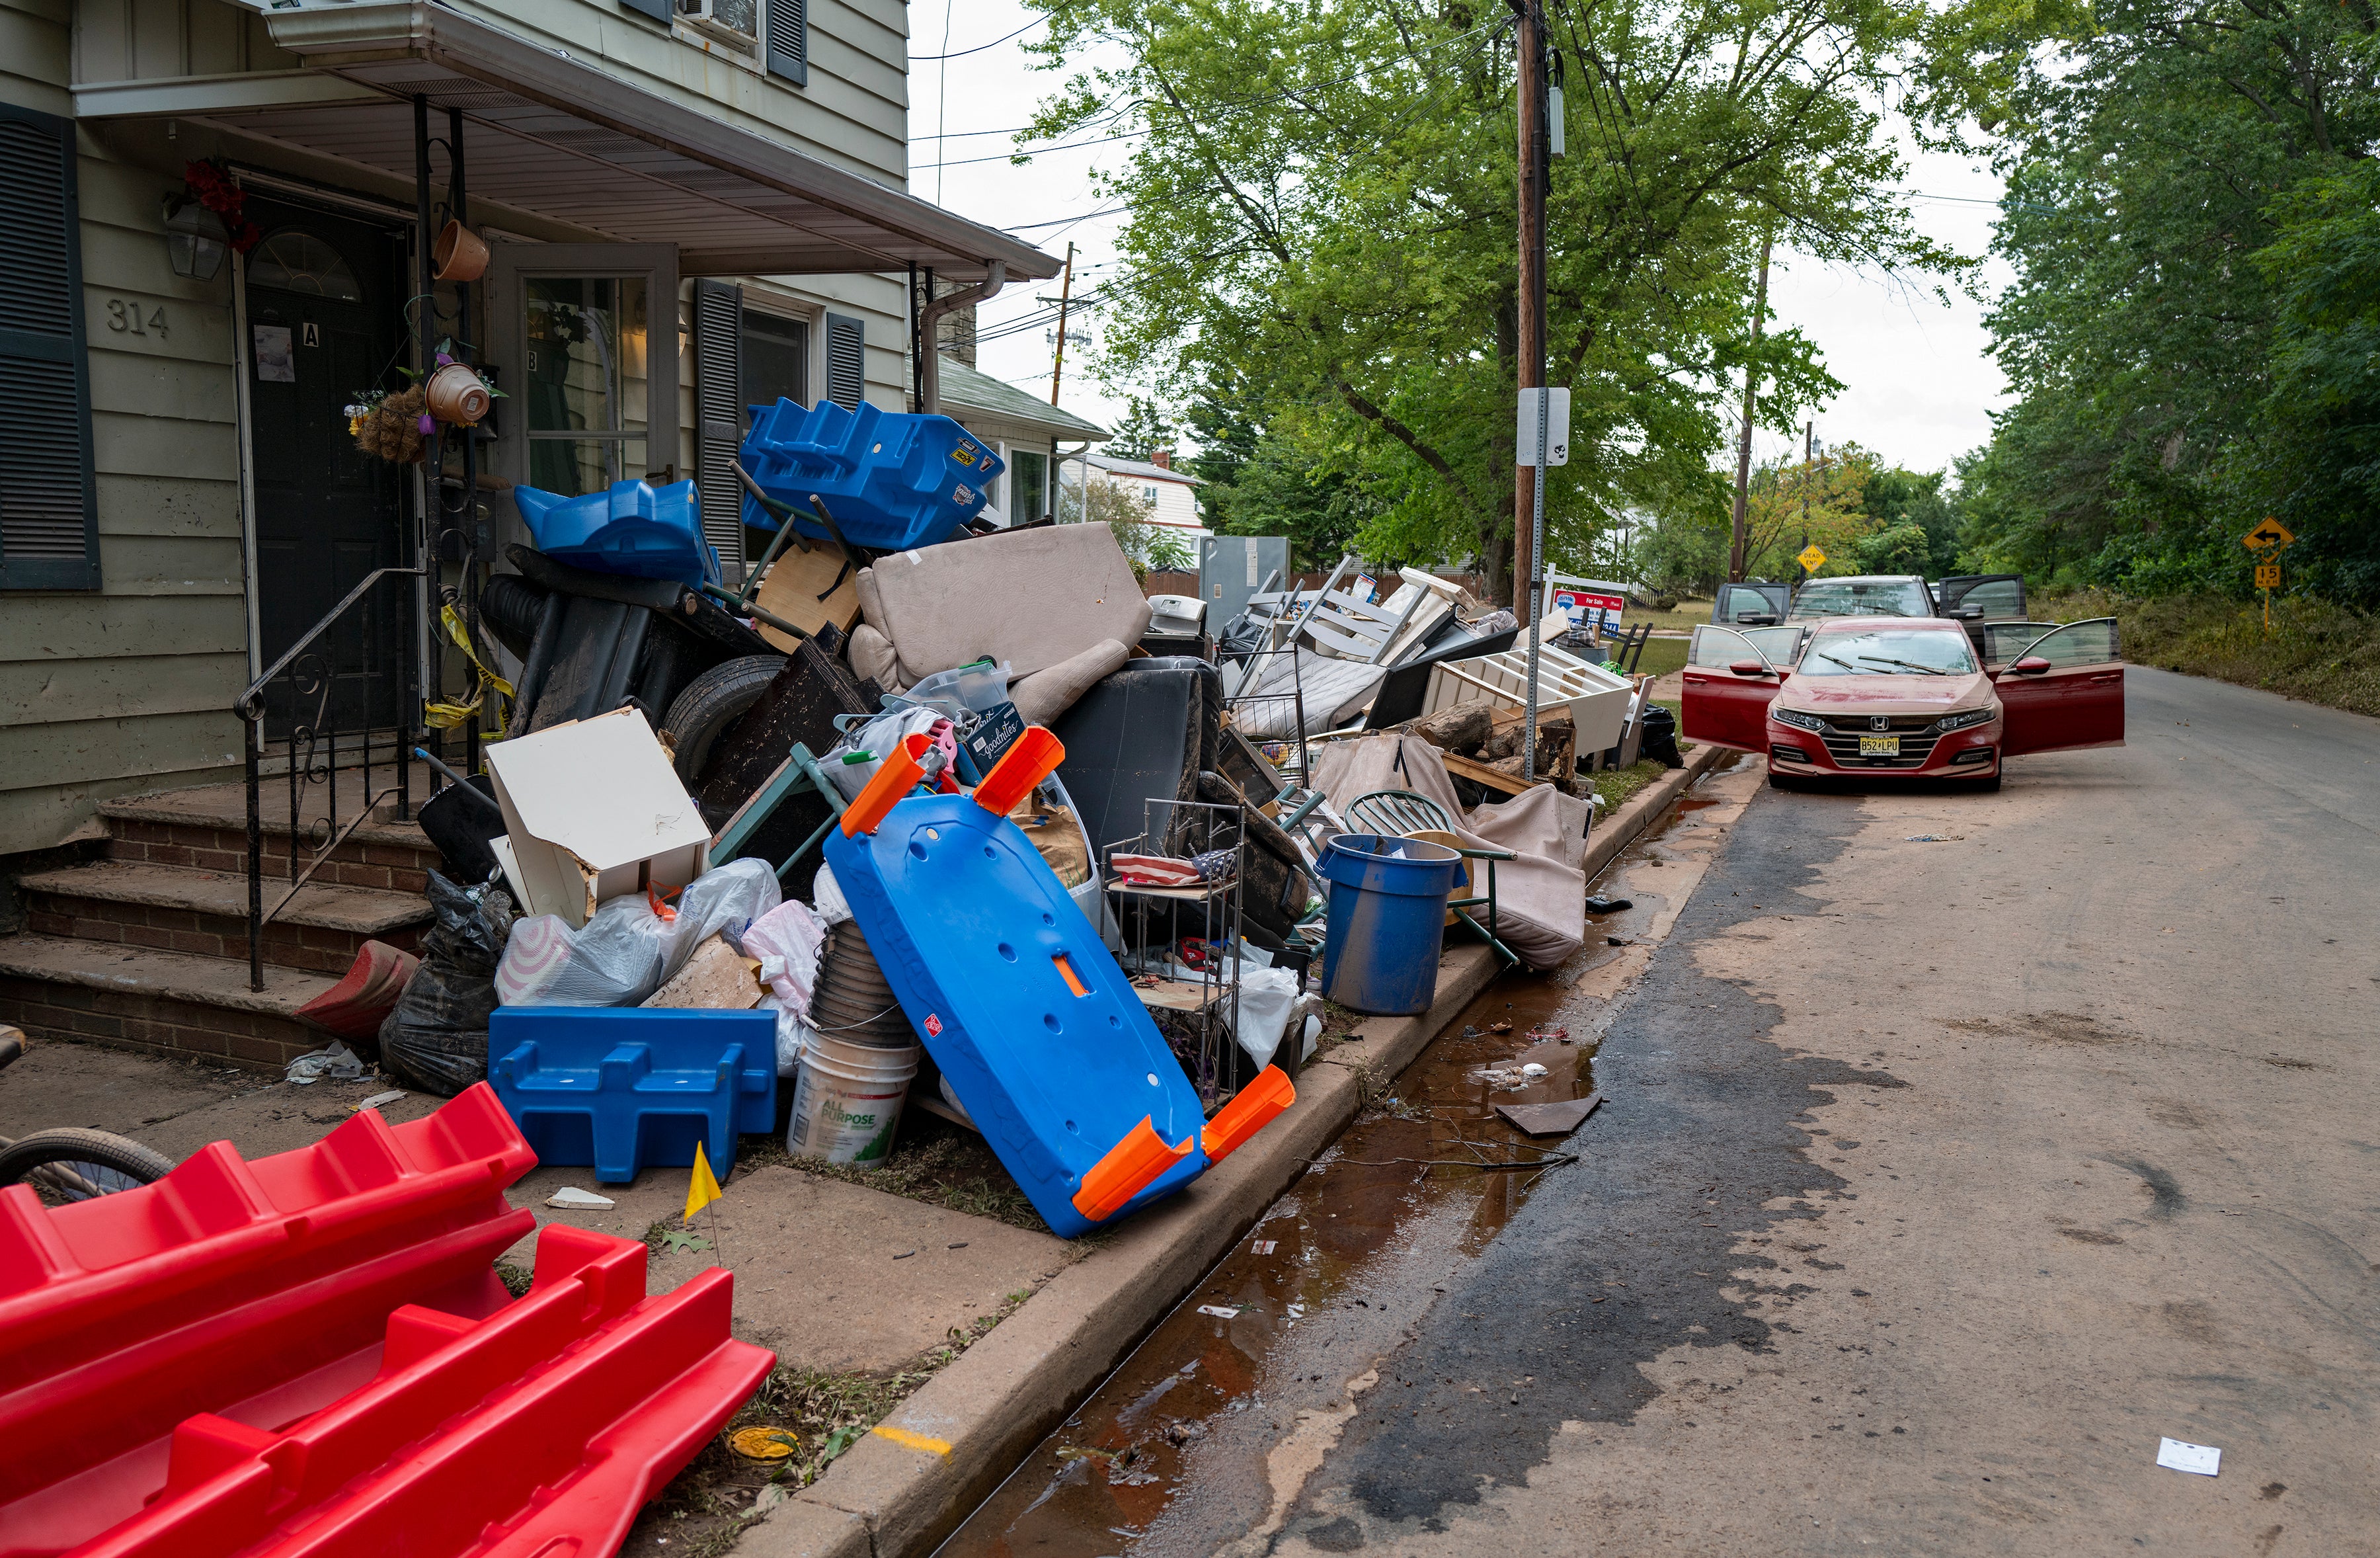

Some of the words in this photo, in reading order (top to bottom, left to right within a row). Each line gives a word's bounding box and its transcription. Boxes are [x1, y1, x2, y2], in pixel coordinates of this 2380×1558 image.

[106, 299, 170, 338] 314
[305, 324, 318, 345] A
[529, 351, 536, 370] B
[2261, 568, 2277, 579] 15
[981, 721, 1017, 759] goodnites
[822, 1099, 844, 1113] ALL
[820, 1109, 876, 1124] PURPOSE
